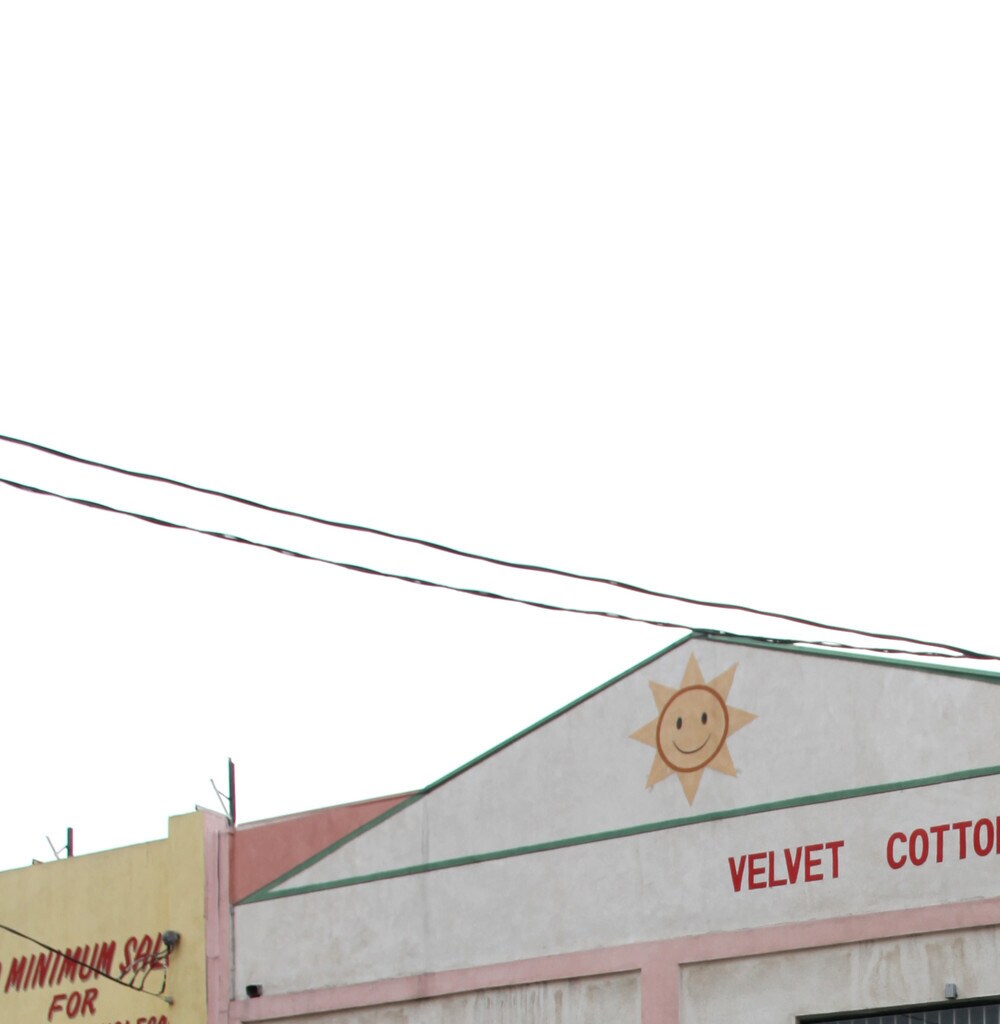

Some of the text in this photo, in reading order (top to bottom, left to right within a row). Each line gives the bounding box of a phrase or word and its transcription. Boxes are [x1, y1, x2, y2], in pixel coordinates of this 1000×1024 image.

[728, 840, 844, 892] VELVET
[5, 939, 117, 993] MINIMUM
[48, 988, 99, 1021] FOR
